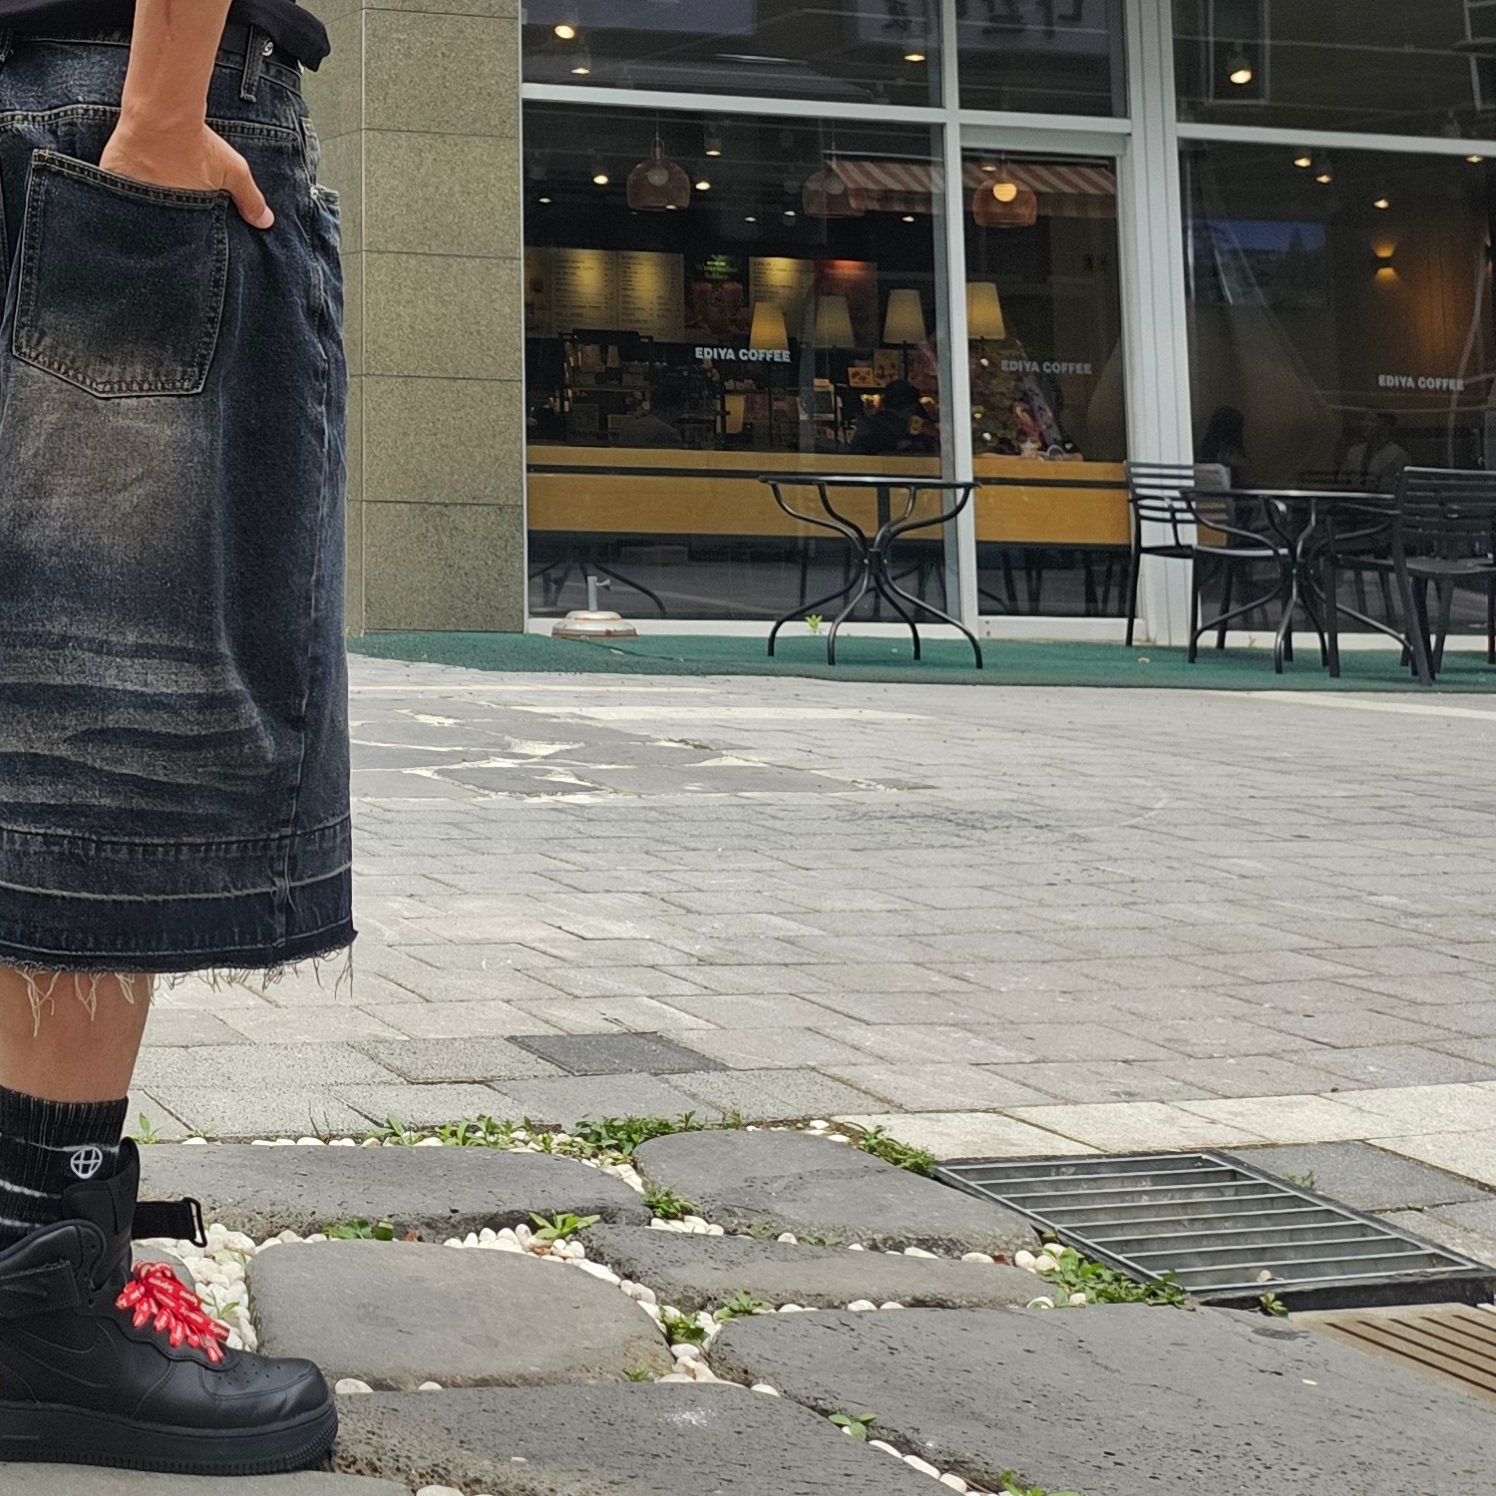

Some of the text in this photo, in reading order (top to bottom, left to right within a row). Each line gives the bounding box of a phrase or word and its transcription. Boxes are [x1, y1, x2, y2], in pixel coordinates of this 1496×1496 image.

[694, 346, 793, 363] EDIYA COFFEE
[1000, 359, 1093, 375] EDIYA COFFEE
[1378, 374, 1465, 392] EDIYA COFFEE
